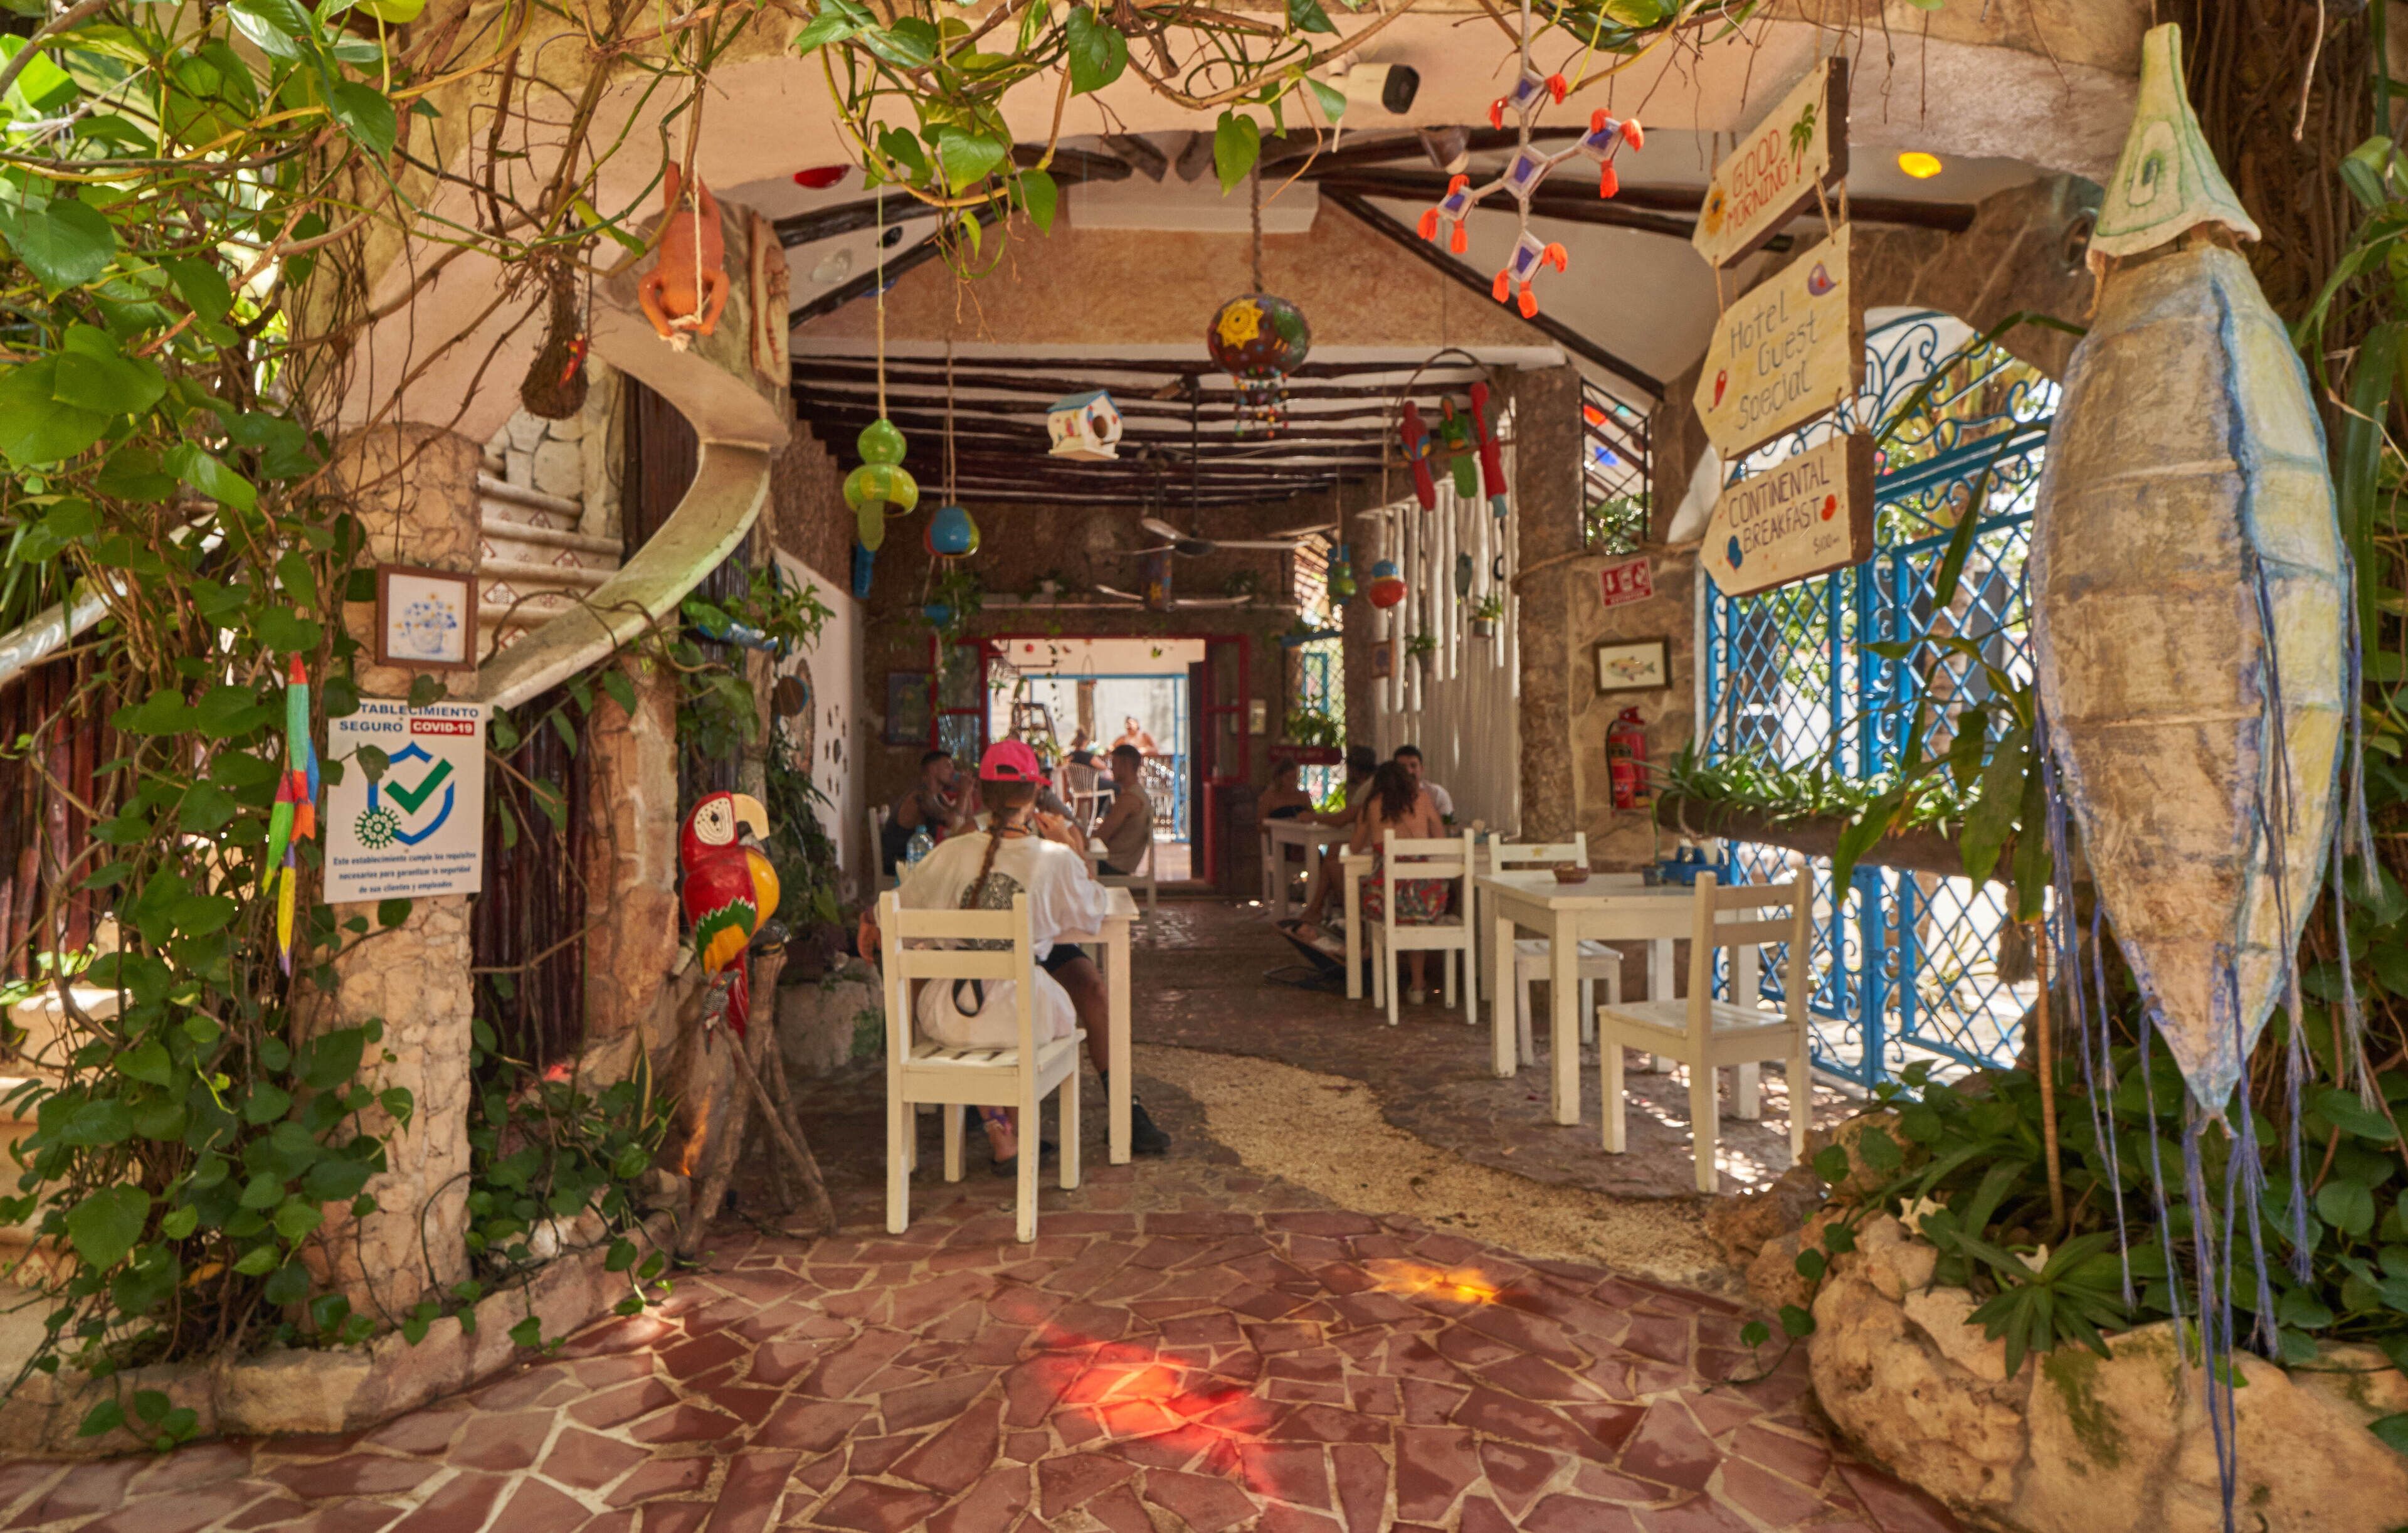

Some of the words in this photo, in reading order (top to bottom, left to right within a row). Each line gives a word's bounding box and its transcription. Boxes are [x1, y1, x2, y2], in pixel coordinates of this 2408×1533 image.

[1733, 129, 1780, 198] GOOD
[1758, 309, 1817, 376] Guest
[1729, 456, 1830, 528] CONTINENTAL
[1743, 497, 1820, 554] BREAKFAST
[339, 721, 403, 732] SEGURO
[412, 721, 473, 734] COVID-19
[361, 703, 478, 718] TABLECIMIENTO
